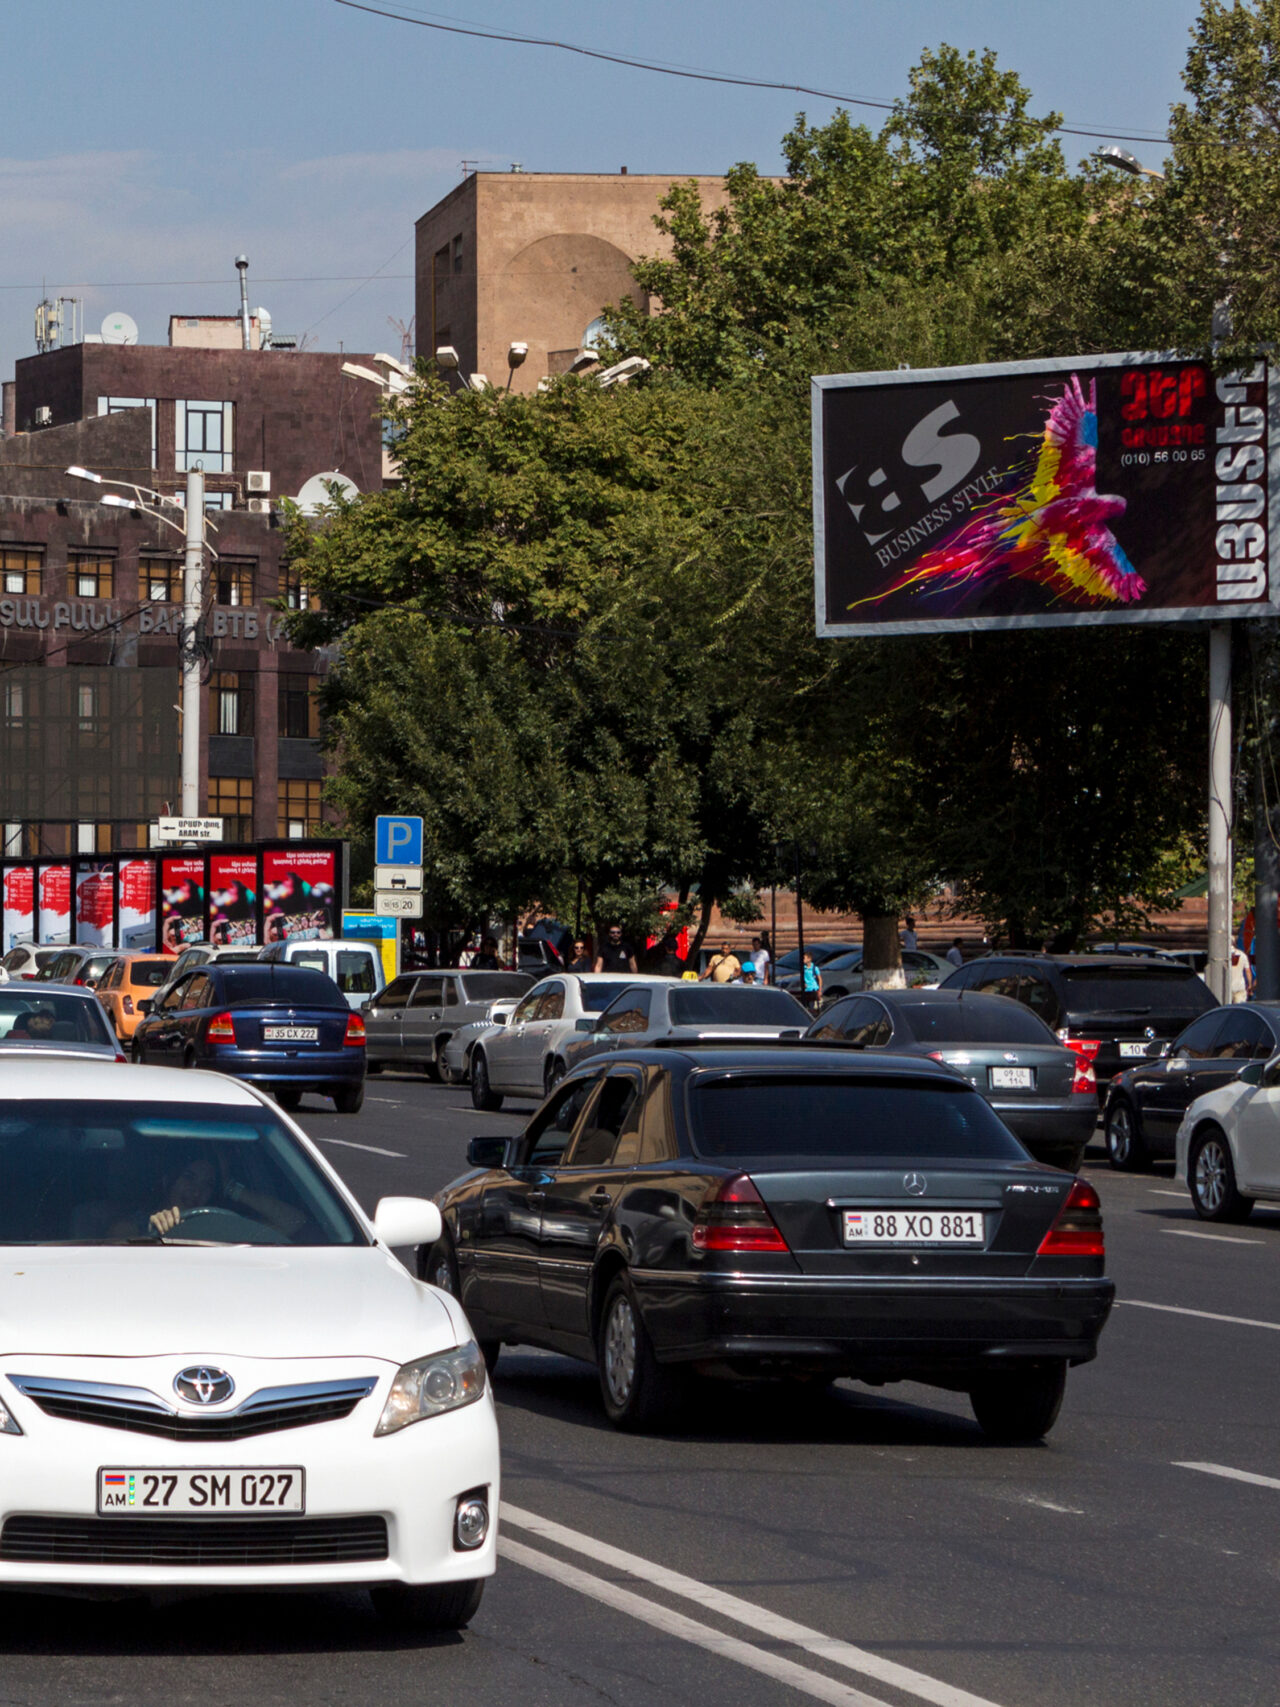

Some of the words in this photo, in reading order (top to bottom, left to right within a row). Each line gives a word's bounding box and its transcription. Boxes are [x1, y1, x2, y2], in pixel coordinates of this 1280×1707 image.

[1121, 366, 1206, 420] ՁԵՐ
[1120, 453, 1150, 466] (010)
[1154, 451, 1169, 463] 56
[1172, 451, 1187, 461] 00
[1190, 449, 1206, 460] 65
[875, 503, 953, 568] BUSINESS
[951, 466, 1004, 513] STYLE
[213, 611, 259, 640] ВТБ
[387, 822, 412, 859] P
[402, 900, 413, 910] 20
[301, 1029, 315, 1039] 222
[848, 1228, 863, 1237] AM
[874, 1215, 898, 1237] 88
[940, 1215, 977, 1238] 881
[105, 1493, 126, 1506] AM
[143, 1474, 178, 1506] 27
[189, 1474, 231, 1506] SM
[241, 1474, 293, 1506] 027
